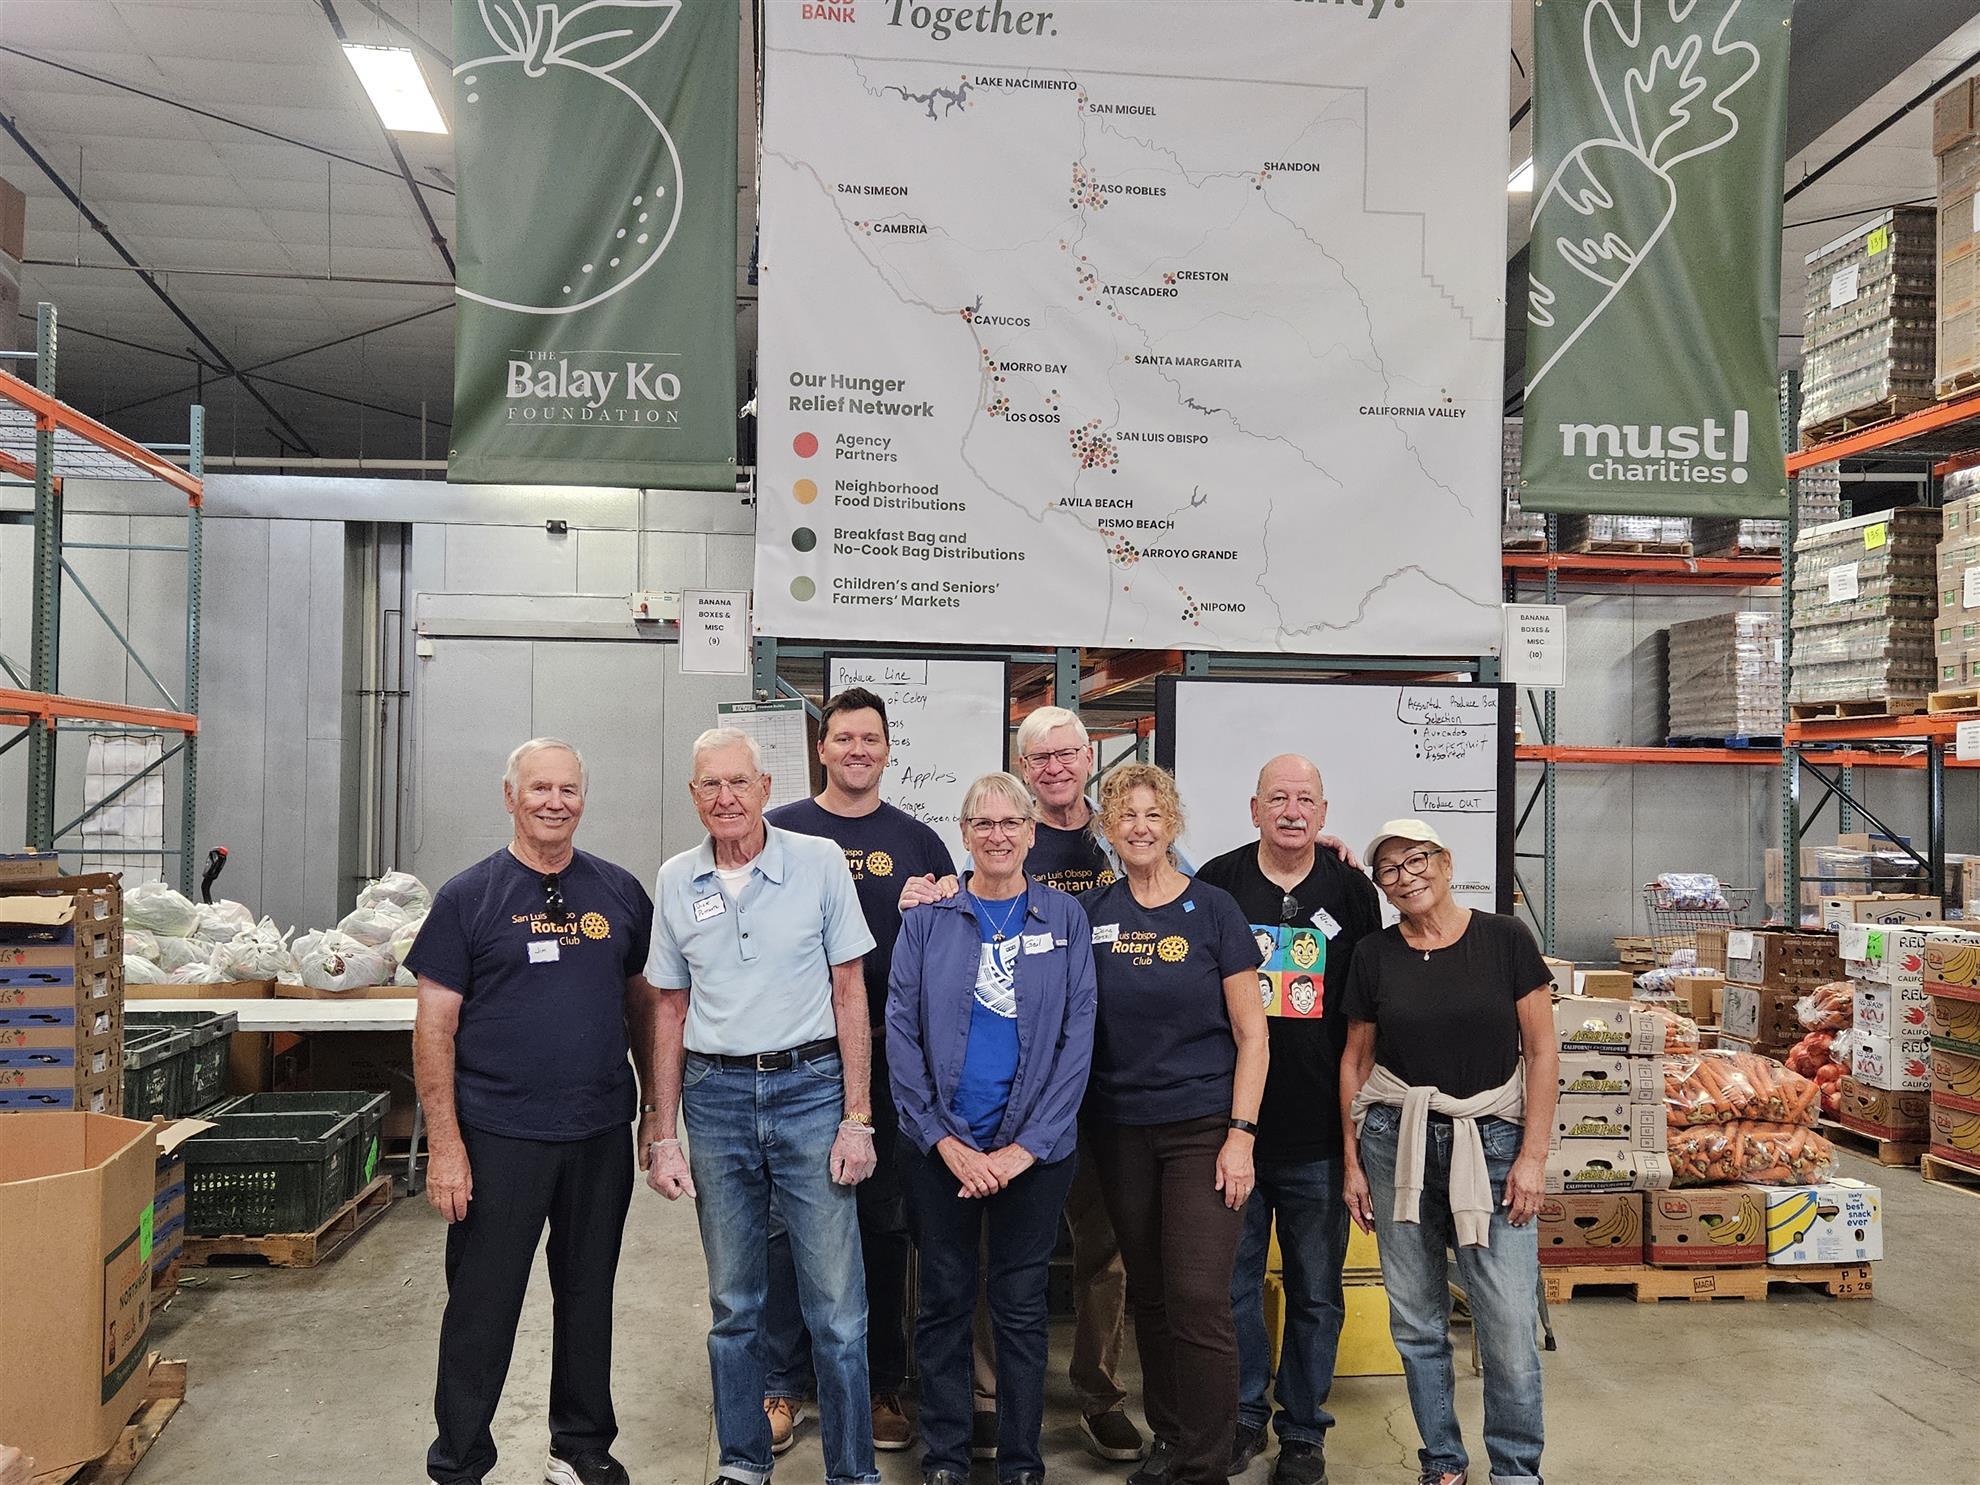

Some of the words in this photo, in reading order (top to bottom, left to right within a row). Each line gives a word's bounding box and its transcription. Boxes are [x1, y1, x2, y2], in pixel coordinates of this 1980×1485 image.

[802, 4, 856, 23] BANK
[886, 0, 1058, 41] Together.
[975, 76, 1002, 88] LAKE
[1005, 78, 1077, 91] NACIMIENTO
[1089, 104, 1113, 115] SAN
[1115, 105, 1157, 116] MIGUEL
[1263, 162, 1320, 172] SHANDON
[837, 184, 861, 194] SAN
[864, 185, 908, 196] SIMEON
[1092, 184, 1122, 195] PASO
[1125, 185, 1167, 197] ROBLES
[873, 223, 928, 235] CAMBRIA
[1176, 271, 1229, 282] CRESTON
[1102, 285, 1178, 297] ATASCADERO
[974, 315, 1031, 327] CAYUCOS
[528, 350, 557, 361] THE
[1000, 362, 1042, 373] MORRO
[1044, 363, 1068, 374] BAY
[1134, 355, 1173, 367] SANTA
[1175, 357, 1242, 369] MARGARITA
[505, 358, 618, 409] Balay
[626, 362, 681, 401] Ko
[789, 371, 827, 389] Our
[830, 372, 905, 396] Hunger
[789, 395, 846, 414] Relief
[848, 399, 935, 418] Network
[1359, 406, 1425, 417] CALIFORNIA
[1427, 407, 1466, 419] VALLEY
[507, 407, 680, 424] FOUNDATION
[1005, 413, 1027, 423] LOS
[1029, 414, 1060, 424] OSOS
[835, 433, 892, 451] Agency
[1116, 431, 1140, 442] SAN
[1142, 432, 1165, 443] LUIS
[1166, 433, 1209, 445] OBISPO
[835, 448, 897, 463] Partners
[1588, 459, 1727, 484] charities
[834, 479, 939, 496] Neighborhood
[834, 495, 871, 508] Food
[873, 496, 966, 513] Distributions
[1059, 498, 1093, 508] AVILA
[1095, 498, 1133, 509] BEACH
[1098, 519, 1134, 530] PISMO
[1136, 519, 1174, 531] BEACH
[834, 528, 904, 543] Breakfast
[908, 530, 936, 547] Bag
[939, 531, 967, 544] and
[834, 543, 899, 557] No-Cook
[902, 545, 930, 561] Bag
[933, 547, 1025, 562] Distributions
[1142, 549, 1189, 560] ARROYO
[1191, 550, 1238, 561] GRANDE
[833, 578, 908, 592] Children’s
[911, 580, 939, 593] and
[943, 580, 1000, 594] Seniors’
[833, 593, 899, 607] Farmers’
[901, 594, 960, 608] Markets
[1200, 602, 1246, 613] NIPOMO
[708, 638, 720, 646] (9)
[1529, 651, 1543, 659] (10)
[839, 667, 875, 684] Produce
[885, 668, 911, 681] Line
[887, 692, 899, 705] of
[1450, 695, 1479, 708] Produce
[1482, 695, 1496, 707] Box
[1424, 712, 1461, 725] Selection
[1423, 728, 1467, 737] Avocados
[901, 764, 957, 789] Apples
[1423, 793, 1454, 809] Produce
[923, 813, 950, 824] Green
[1048, 871, 1063, 880] Luis
[1065, 869, 1092, 878] Obispo
[1048, 881, 1093, 891] Rotary
[511, 914, 528, 924] San
[530, 911, 547, 921] Luis
[530, 921, 578, 935] Rotary
[560, 936, 580, 946] Club
[1120, 931, 1130, 940] uis
[1131, 931, 1157, 941] Obispo
[1111, 941, 1155, 956] Rotary
[1899, 937, 1925, 948] RED
[1132, 957, 1153, 966] Club
[1901, 989, 1928, 1001] RED
[1901, 1041, 1929, 1053] RED
[1664, 1202, 1687, 1211] Dole
[1848, 1210, 1872, 1218] snack
[1839, 1284, 1853, 1293] 25
[1858, 1282, 1872, 1291] 26
